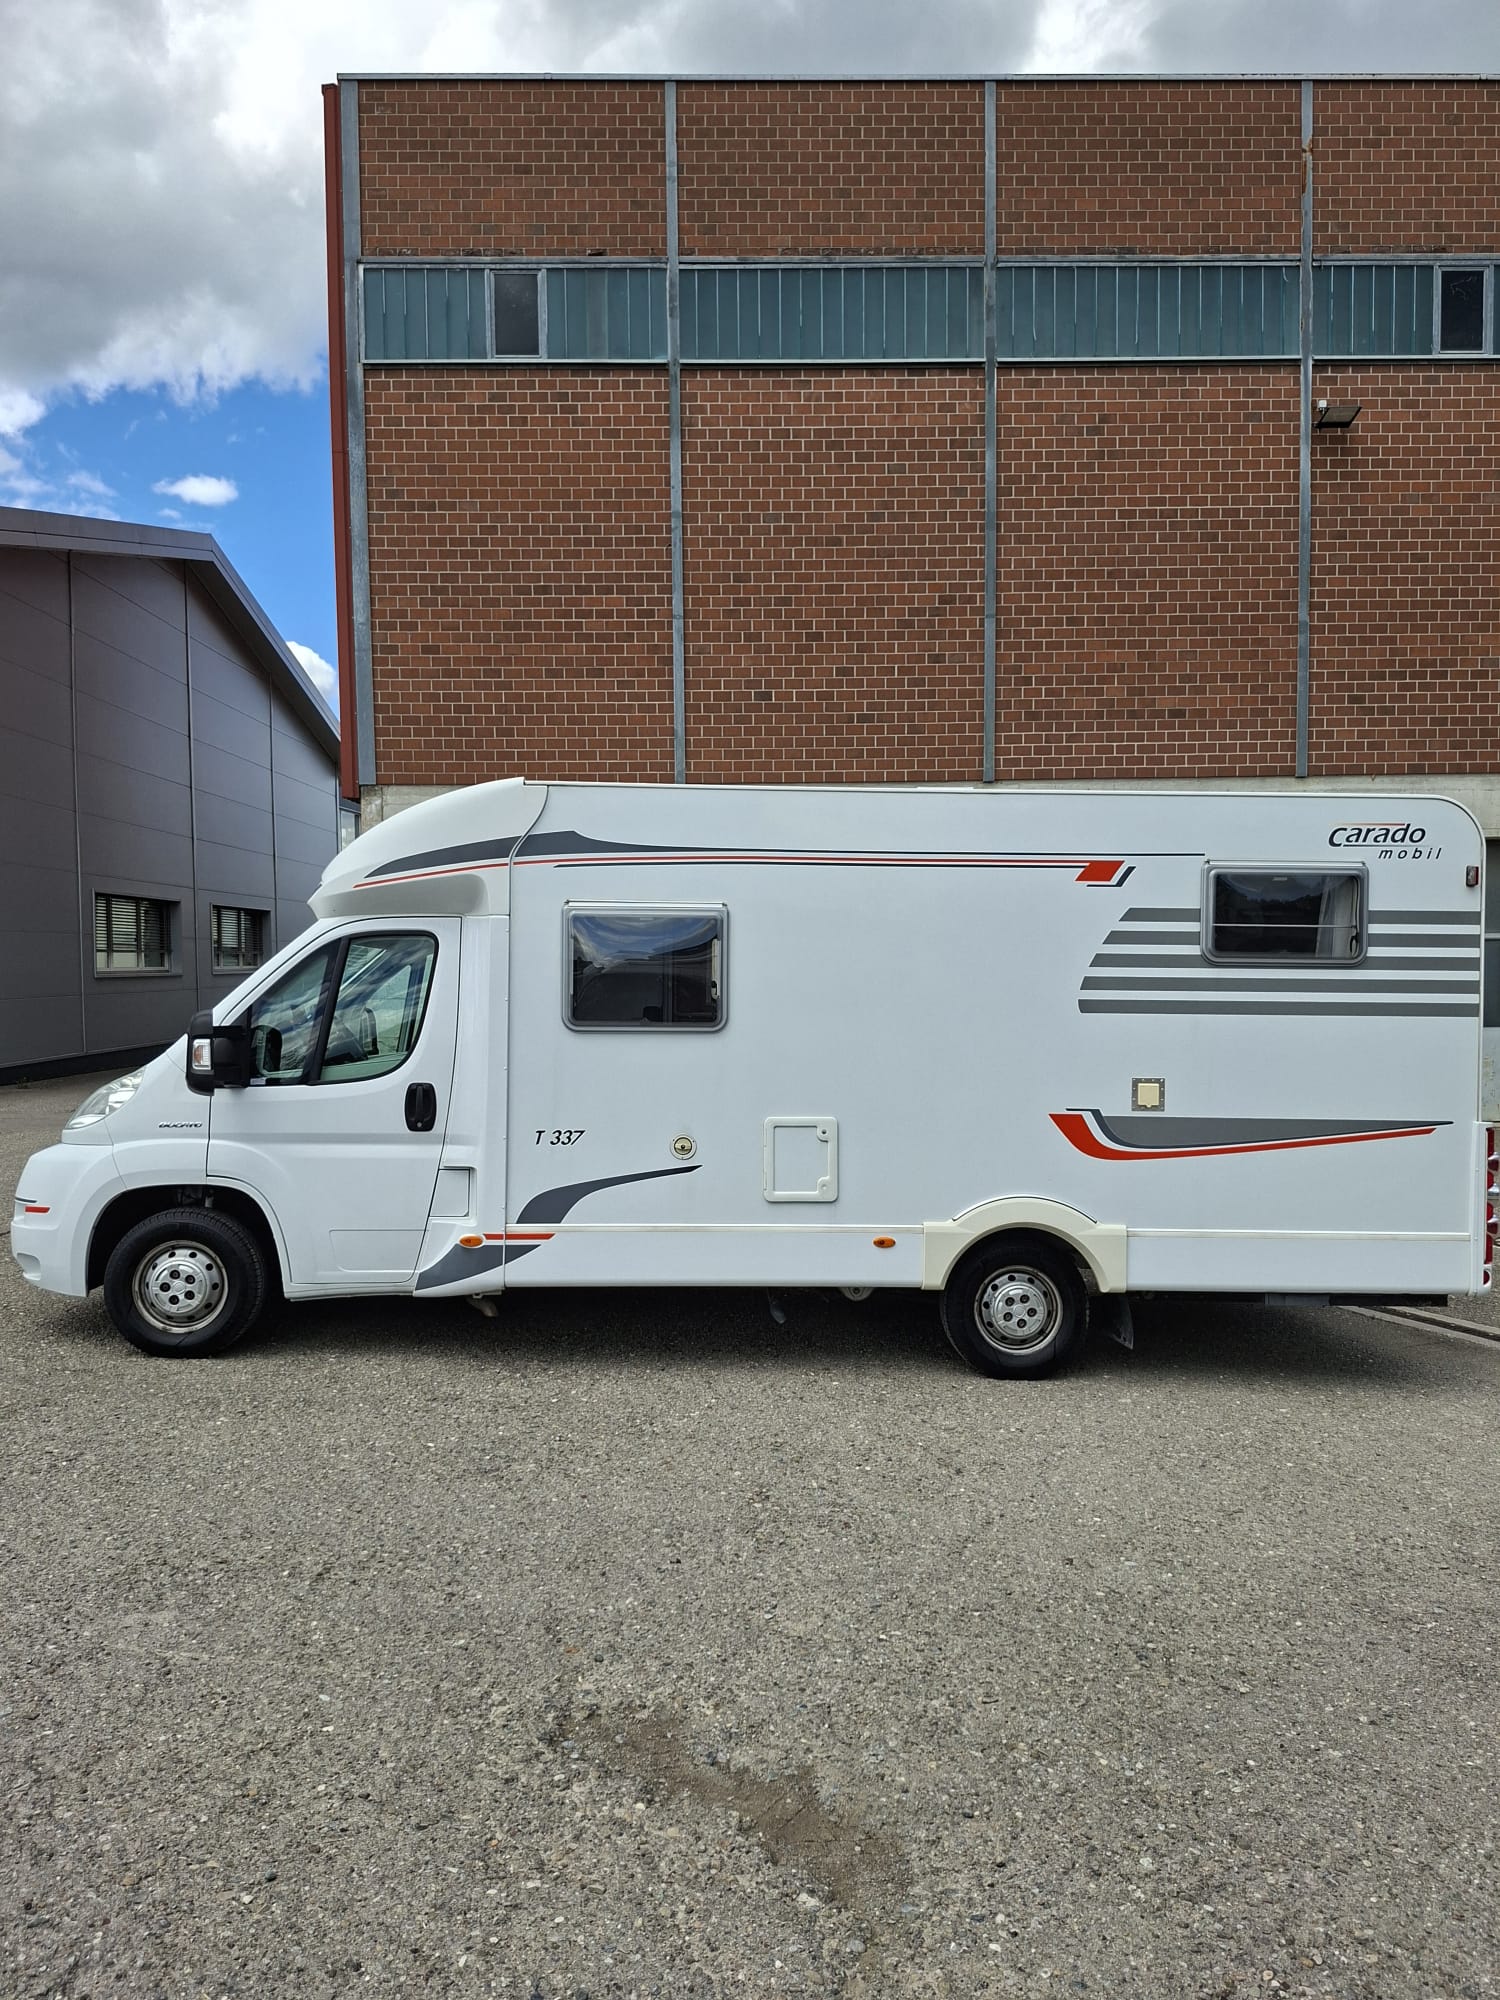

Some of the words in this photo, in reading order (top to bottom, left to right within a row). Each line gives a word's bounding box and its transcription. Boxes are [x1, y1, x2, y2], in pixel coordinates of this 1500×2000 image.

[1378, 847, 1442, 860] mobil
[535, 1130, 546, 1145] T
[549, 1130, 586, 1146] 337
